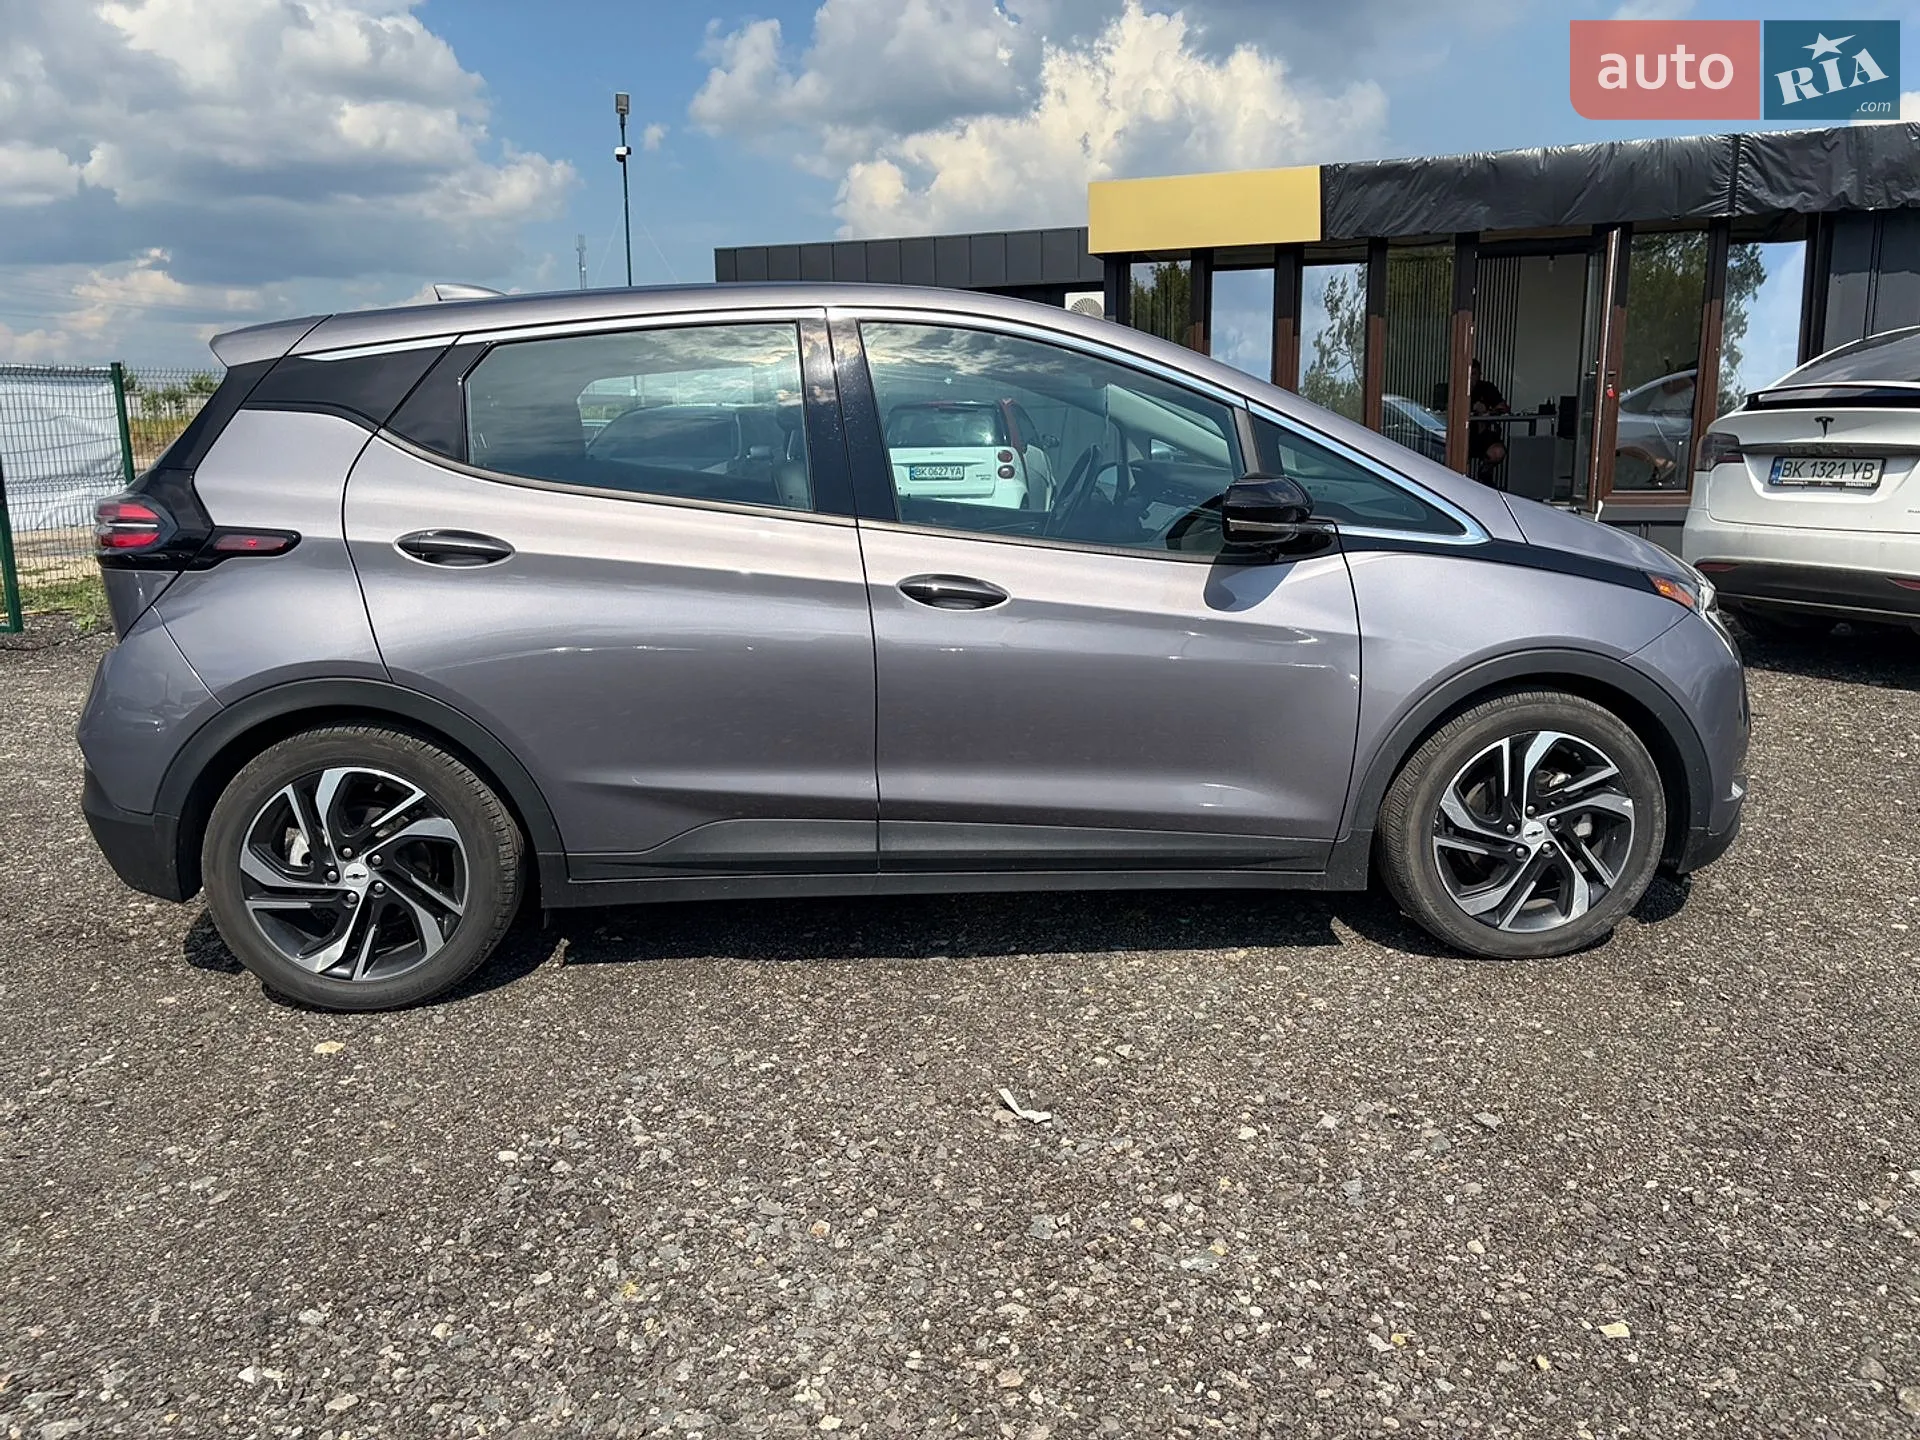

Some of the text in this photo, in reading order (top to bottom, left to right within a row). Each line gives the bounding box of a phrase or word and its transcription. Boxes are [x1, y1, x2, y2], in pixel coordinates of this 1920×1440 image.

[915, 466, 962, 476] BK 0627 YA
[1781, 461, 1875, 480] BK 1321 YB
